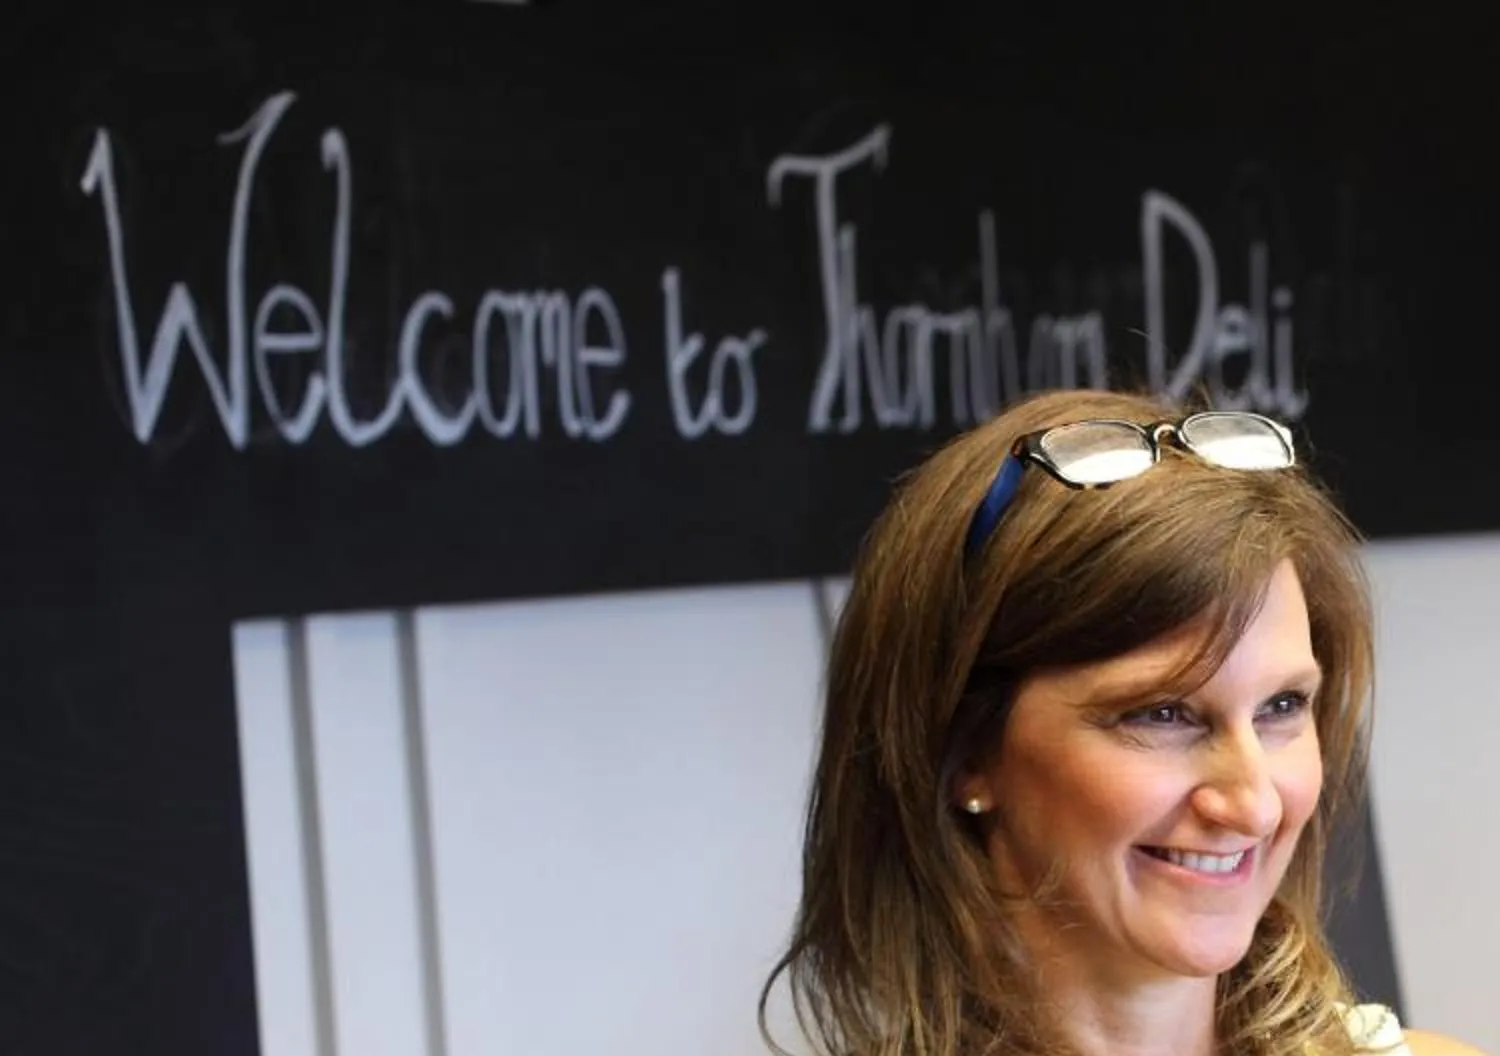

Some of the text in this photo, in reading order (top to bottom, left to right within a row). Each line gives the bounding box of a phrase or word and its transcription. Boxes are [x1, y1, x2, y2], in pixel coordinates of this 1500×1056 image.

[81, 90, 630, 450] Welcome
[662, 266, 768, 440] to
[1141, 188, 1309, 418] Deli
